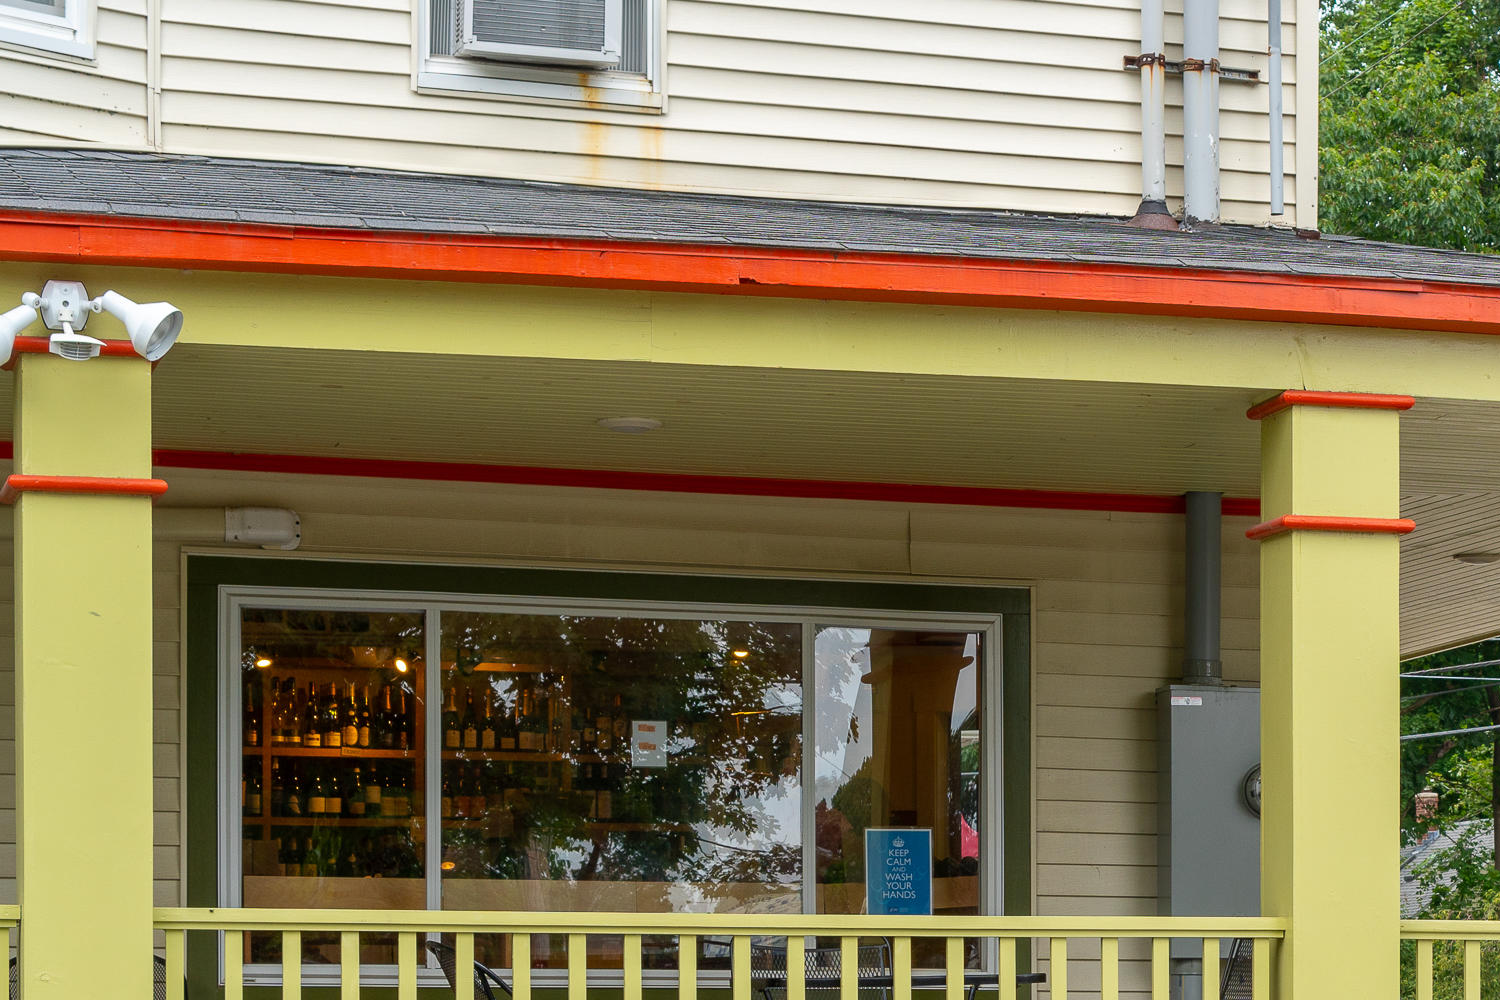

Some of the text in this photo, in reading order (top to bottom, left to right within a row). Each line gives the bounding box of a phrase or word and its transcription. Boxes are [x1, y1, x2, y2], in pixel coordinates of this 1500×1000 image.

[888, 849, 910, 857] KEEP
[886, 858, 912, 866] CALM
[885, 873, 913, 881] WASH
[886, 882, 913, 890] YOUR
[882, 890, 917, 899] HANDS
